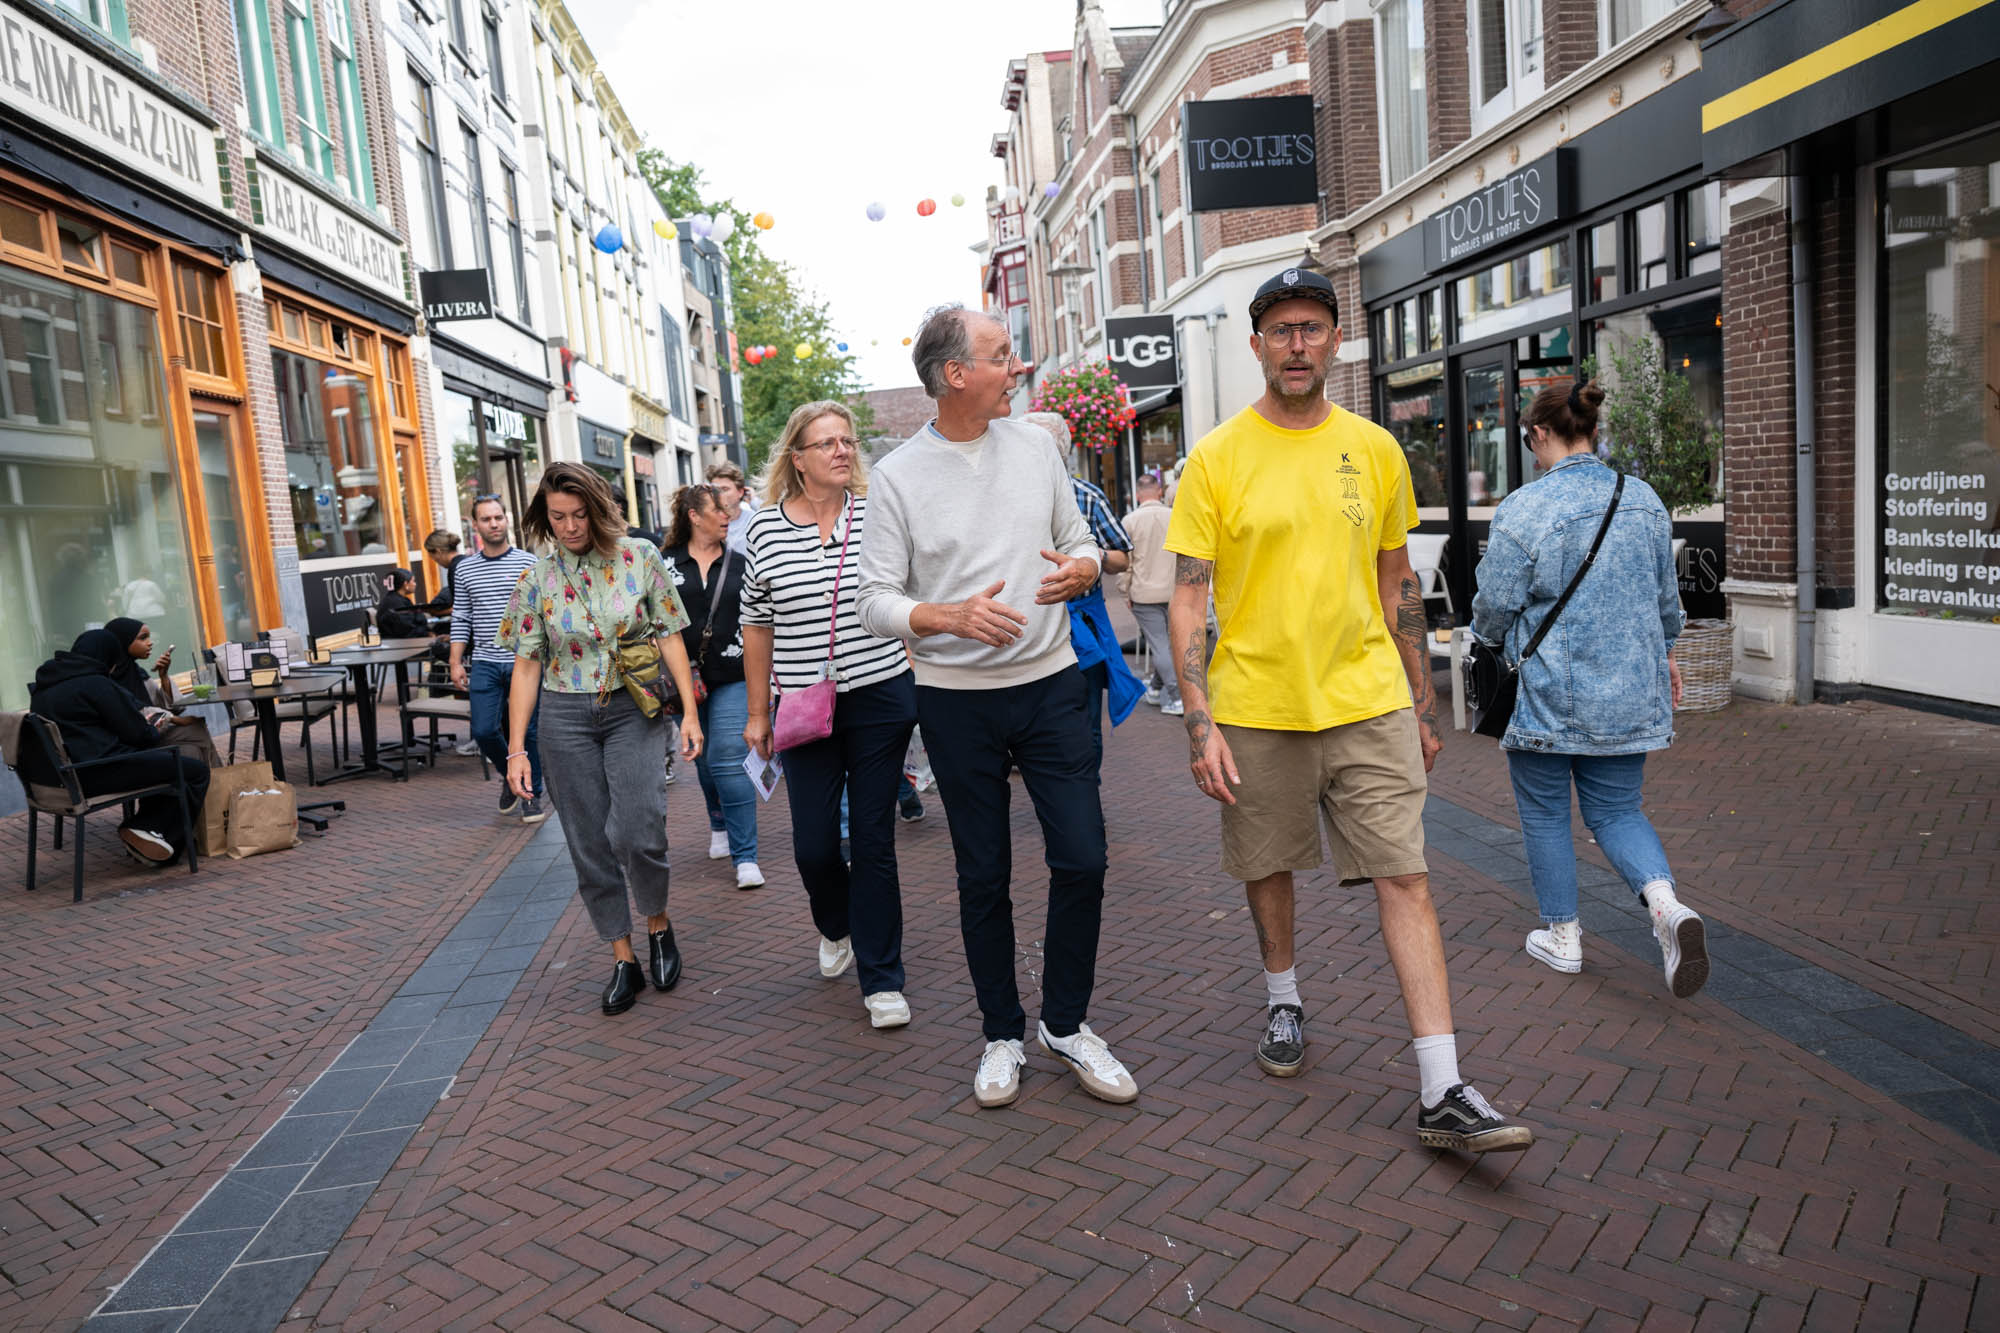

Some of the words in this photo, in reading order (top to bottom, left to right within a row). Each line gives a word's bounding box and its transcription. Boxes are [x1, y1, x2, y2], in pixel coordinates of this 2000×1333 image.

[1190, 134, 1314, 171] TOOTJE'S
[1211, 161, 1249, 170] BROODJES
[1267, 158, 1294, 166] TOOTJE
[258, 170, 325, 252] TABAK
[1435, 168, 1541, 262] TOOTJE'S
[1450, 236, 1480, 258] BROODJES
[1482, 230, 1495, 245] VAN
[1496, 218, 1521, 238] TOOTJE
[428, 300, 488, 319] LIVERA
[1109, 334, 1173, 368] UGG
[1341, 452, 1350, 463] K
[1885, 471, 1986, 495] Gordijnen
[1885, 497, 1988, 521] Stoffering
[1885, 528, 2000, 549] Bankstelku
[1885, 557, 1958, 583] kleding
[1965, 564, 2000, 585] rep
[323, 572, 380, 615] TOOTJE'S
